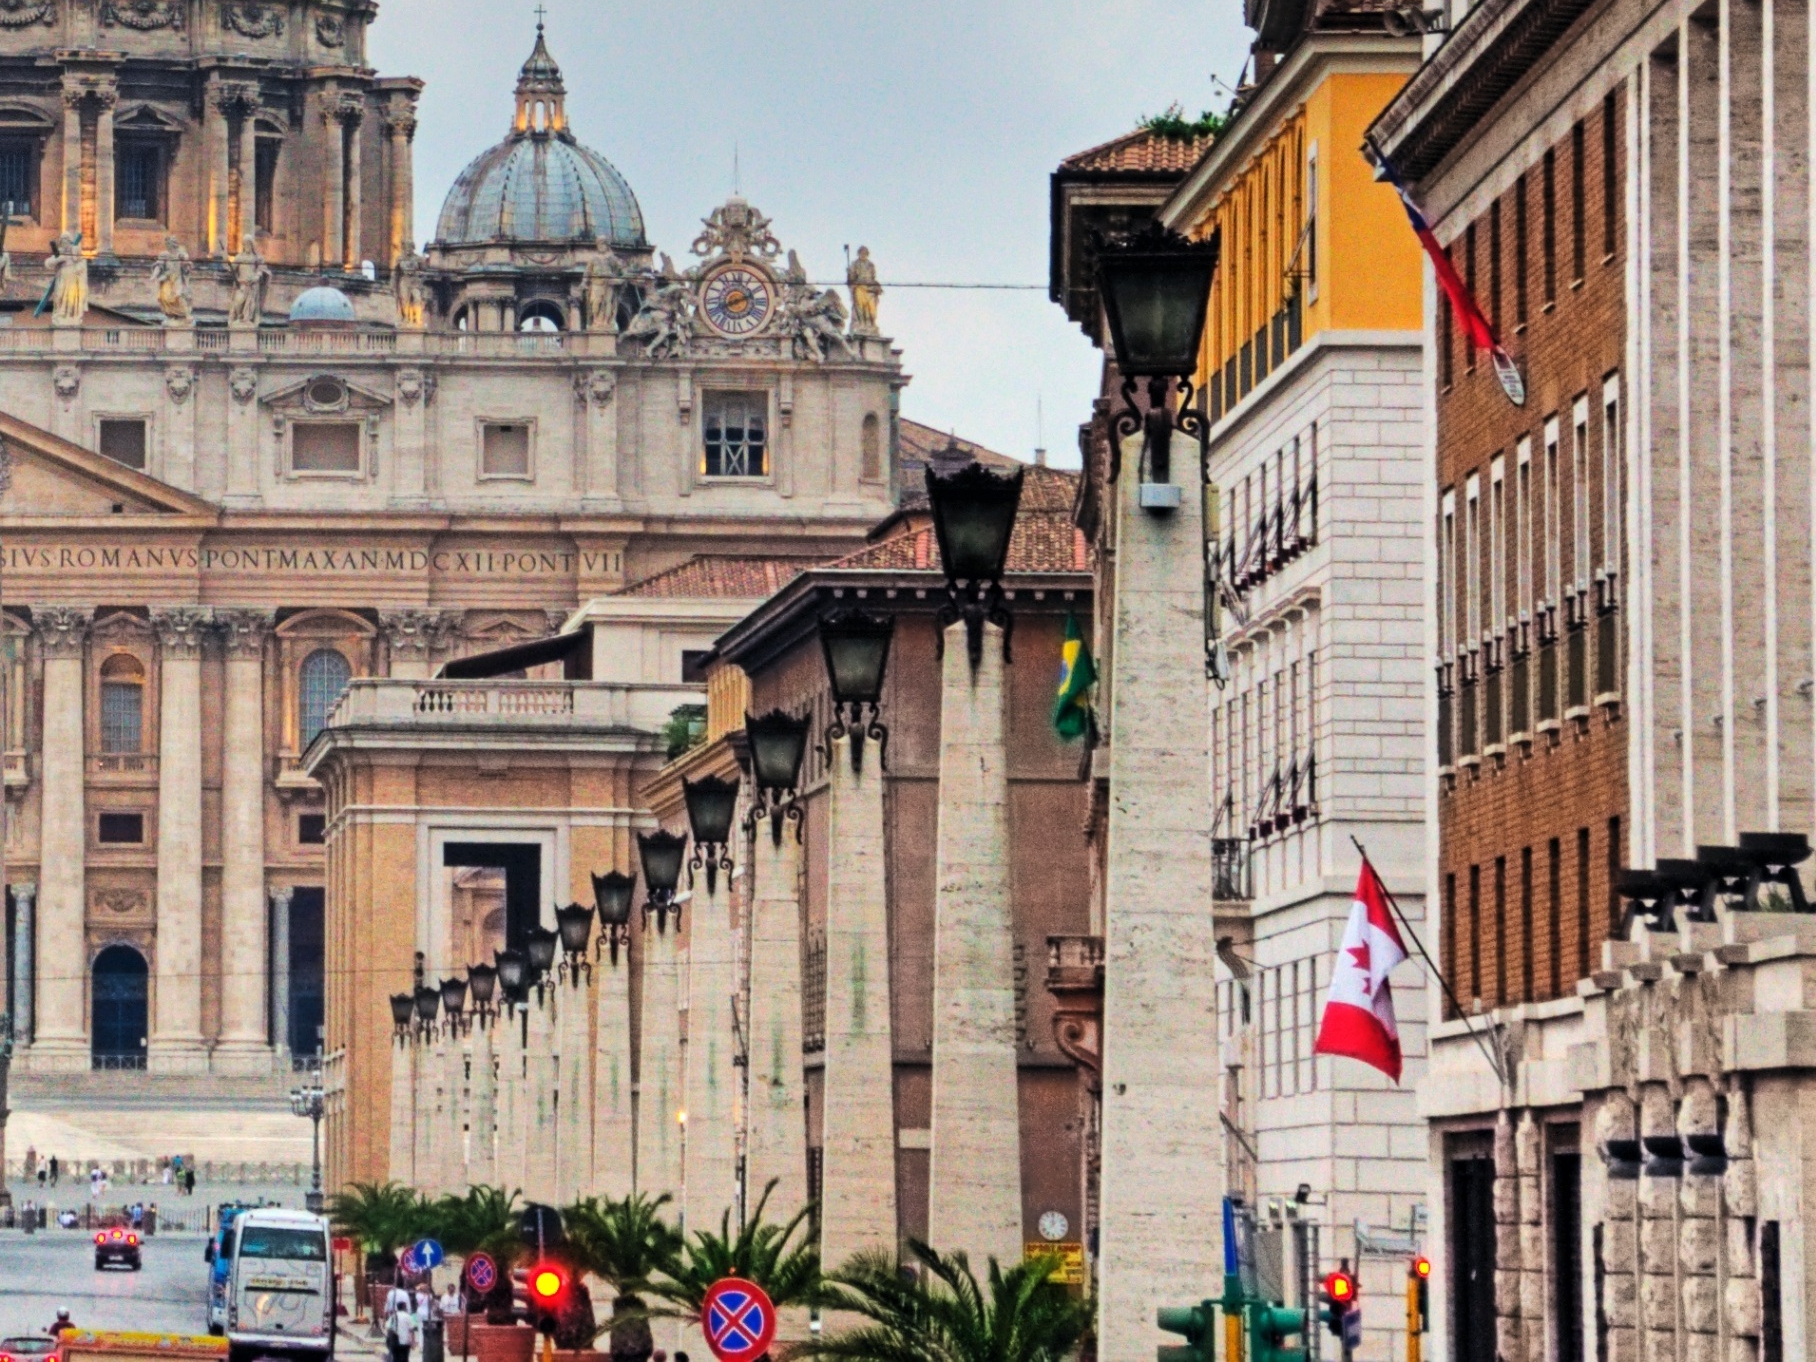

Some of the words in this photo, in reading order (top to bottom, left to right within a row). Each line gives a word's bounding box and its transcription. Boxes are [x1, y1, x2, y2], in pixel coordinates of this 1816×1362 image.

[60, 548, 198, 568] ROMANVS
[205, 549, 277, 569] PONT
[278, 549, 338, 570] MAX
[342, 550, 379, 570] AN
[385, 550, 494, 572] MDCXII
[503, 550, 575, 573] PONT
[583, 551, 621, 573] VII
